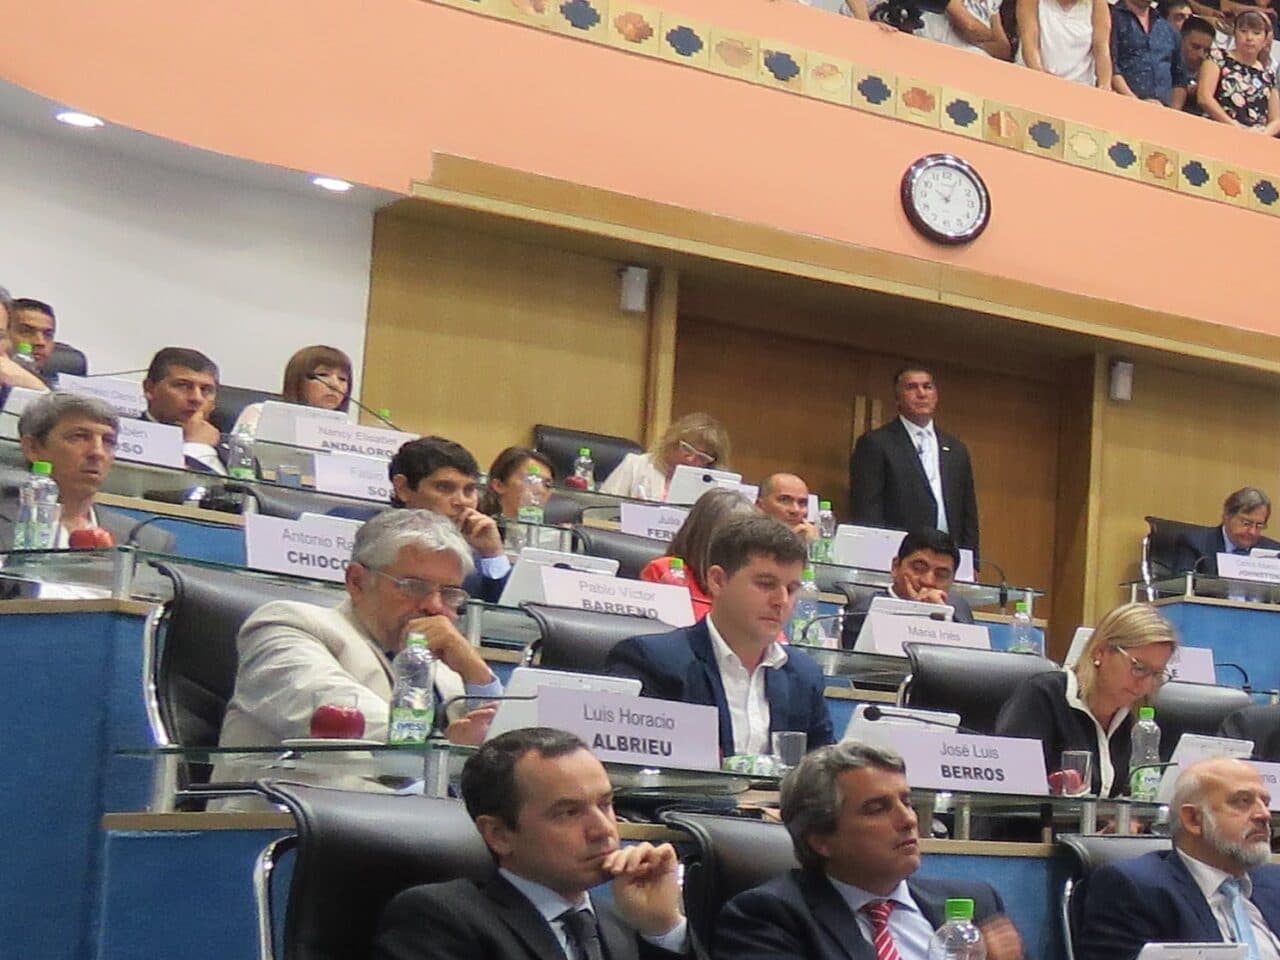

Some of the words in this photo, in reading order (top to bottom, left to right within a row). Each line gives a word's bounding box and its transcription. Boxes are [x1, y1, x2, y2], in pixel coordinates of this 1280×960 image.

[282, 528, 331, 547] Antonio
[336, 536, 354, 550] Ra
[647, 528, 675, 540] FER
[583, 703, 615, 722] Luis
[618, 708, 675, 730] Horacio
[592, 733, 673, 757] ALBRIEU
[940, 741, 970, 757] José
[971, 743, 1000, 760] Luis
[940, 764, 1006, 782] BERROS
